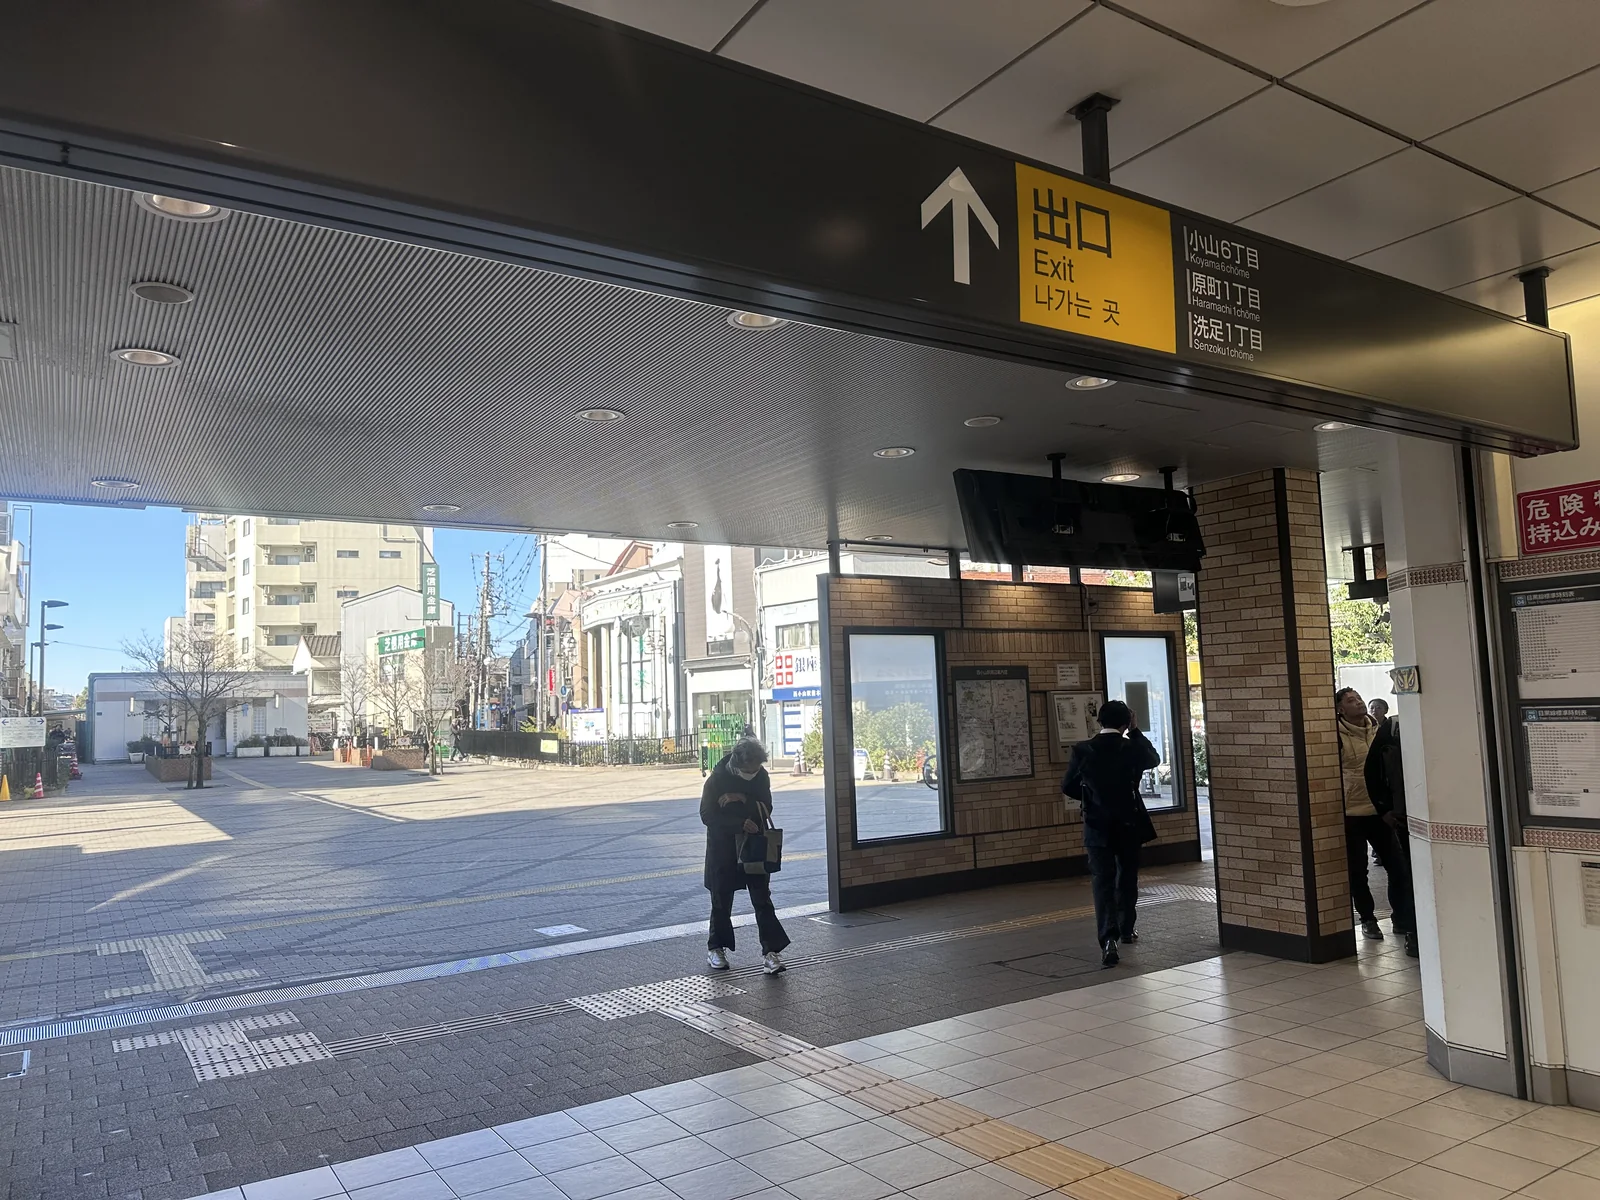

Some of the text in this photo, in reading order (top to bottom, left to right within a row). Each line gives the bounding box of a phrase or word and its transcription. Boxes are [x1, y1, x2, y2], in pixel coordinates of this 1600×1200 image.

[1033, 188, 1112, 258] 出口
[1034, 248, 1074, 283] Exit
[1189, 229, 1259, 270] 小山6丁目
[1035, 284, 1120, 326] 나가는 곳
[1192, 271, 1260, 310] 原町1丁目
[1193, 314, 1262, 351] 洗足1丁目
[1527, 490, 1600, 520] 危険
[1527, 516, 1600, 545] 持込み
[426, 567, 437, 615] 芝信用金庫
[384, 632, 418, 652] 芝信用金庫
